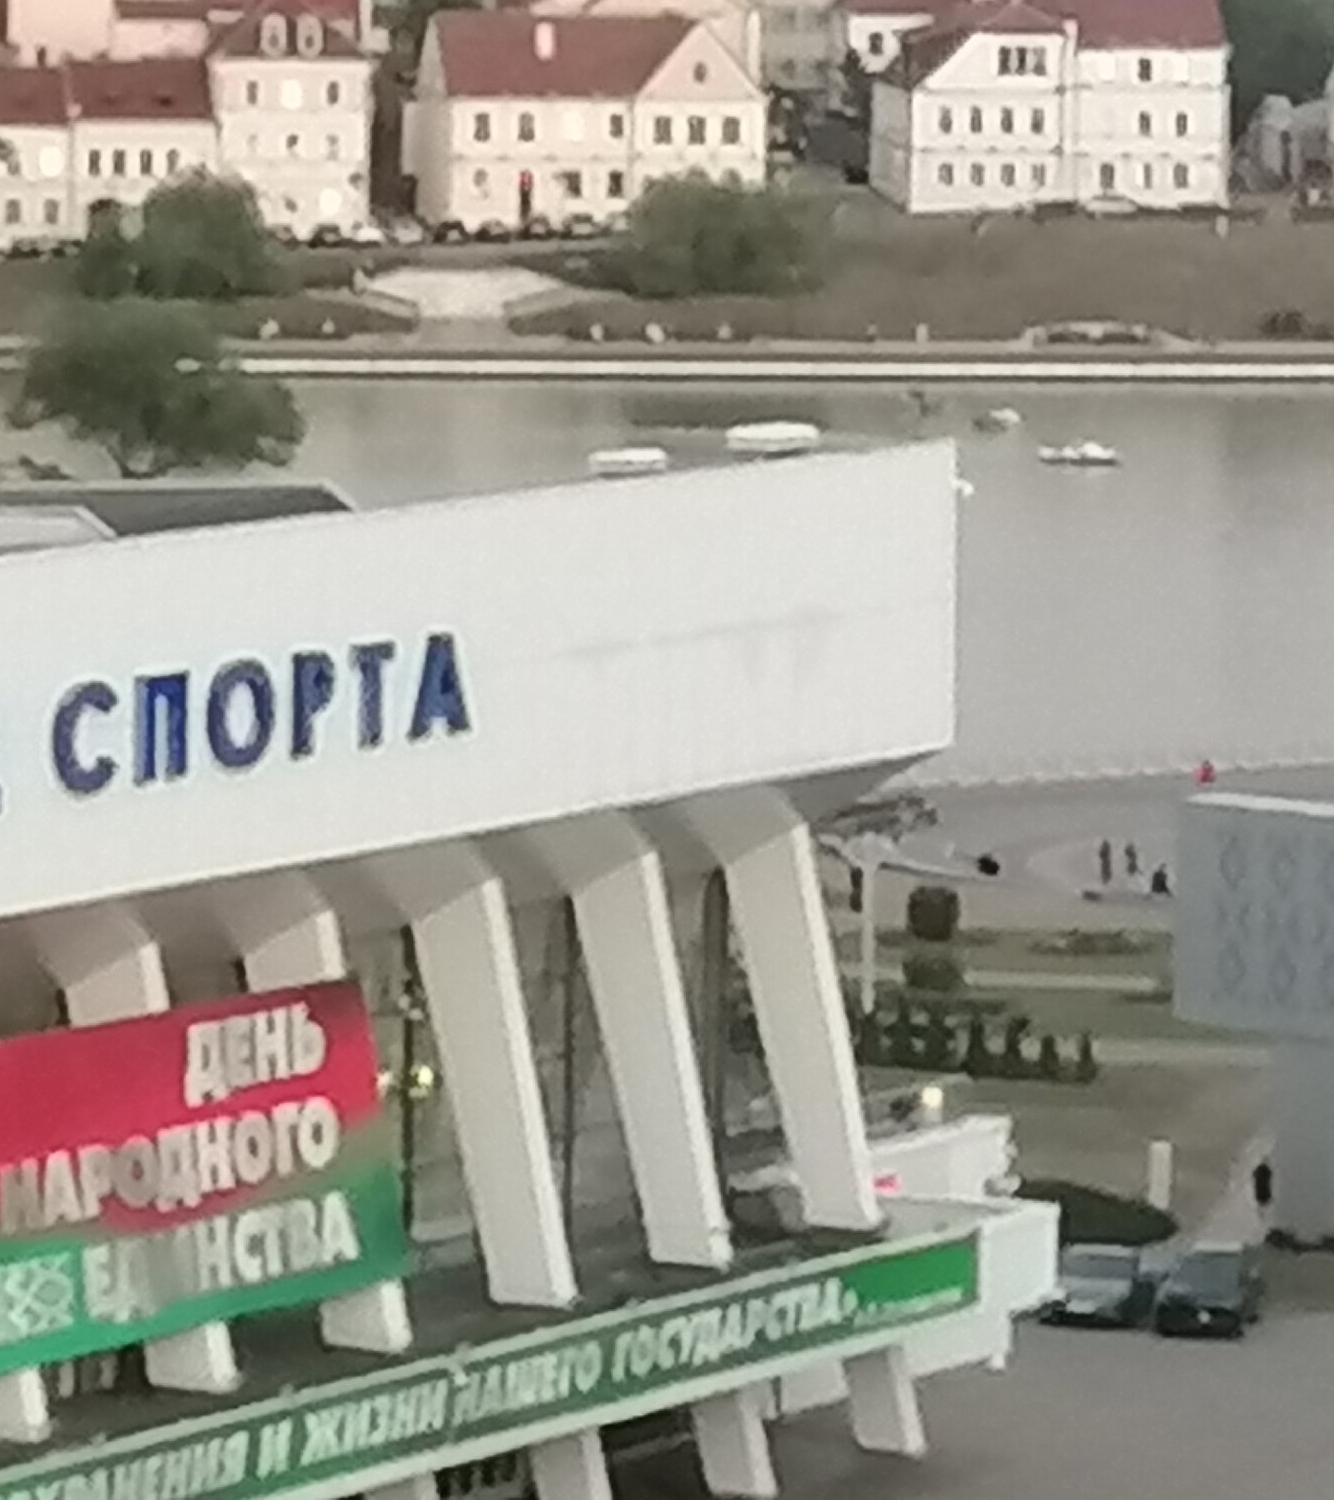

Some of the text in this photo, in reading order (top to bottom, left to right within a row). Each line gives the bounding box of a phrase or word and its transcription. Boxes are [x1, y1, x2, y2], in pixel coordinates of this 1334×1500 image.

[52, 630, 473, 796] СПОРТА
[183, 1000, 327, 1108] ДЕНЬ
[300, 1379, 449, 1462] ЖИЗНИ
